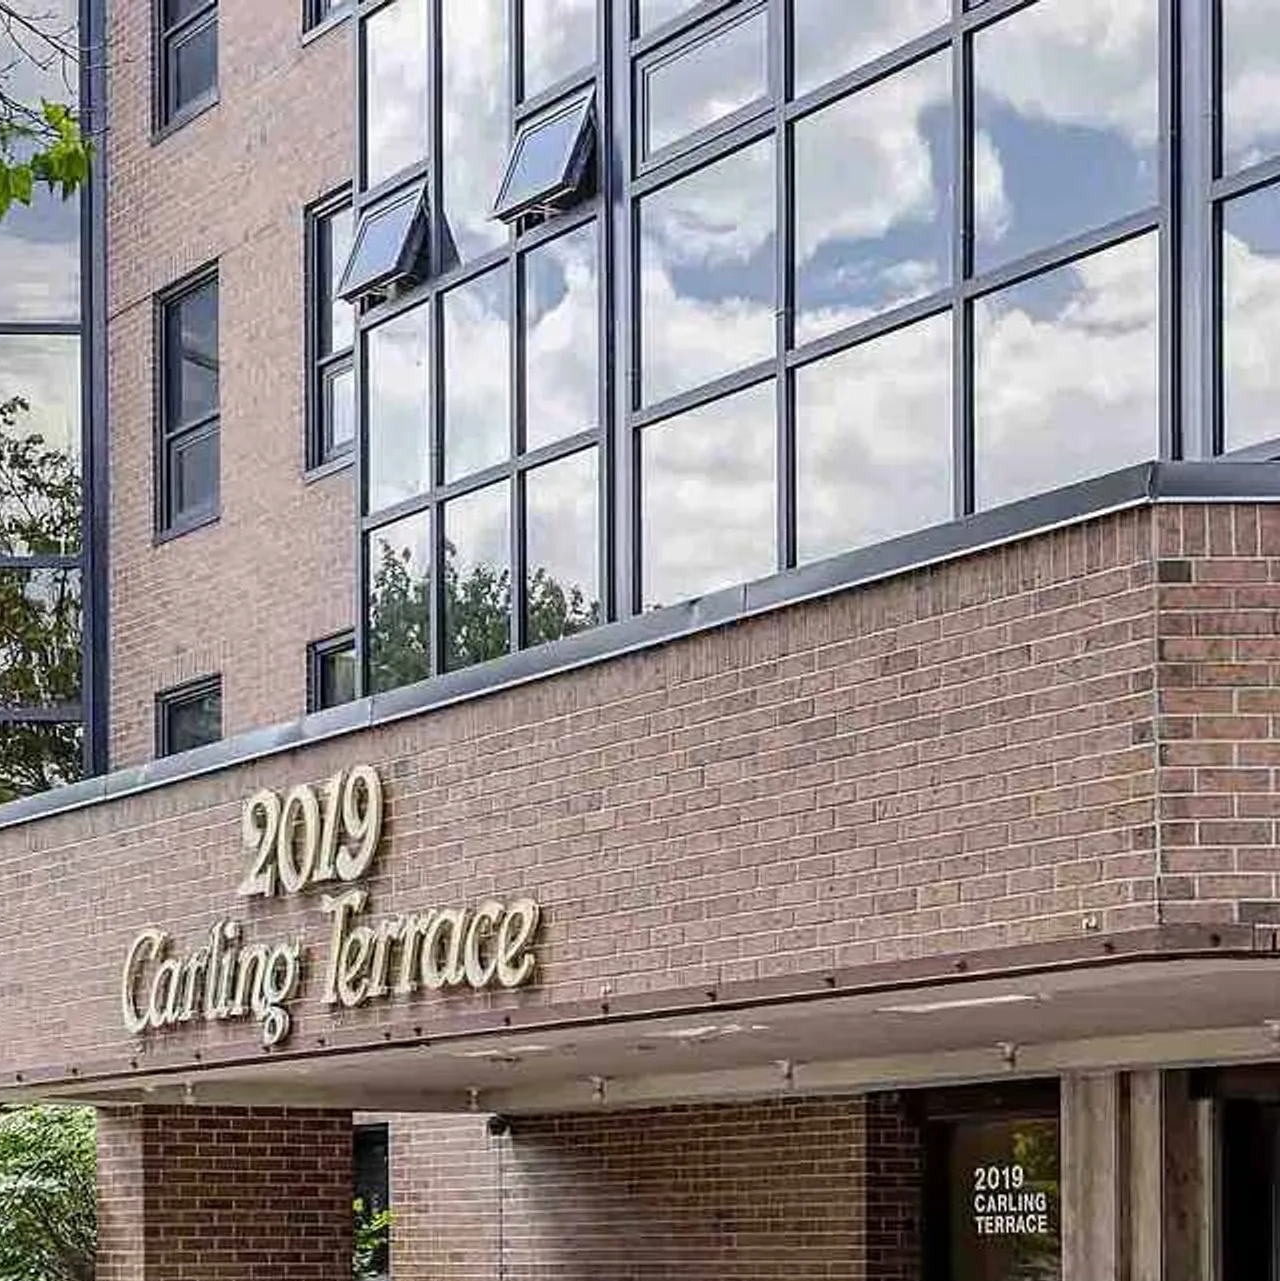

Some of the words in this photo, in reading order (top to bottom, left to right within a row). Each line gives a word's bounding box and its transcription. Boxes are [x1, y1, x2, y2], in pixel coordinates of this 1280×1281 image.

[238, 764, 384, 897] 2019
[123, 920, 302, 1045] Carling
[322, 889, 540, 1007] Terrace
[974, 1165, 1024, 1191] 2019
[974, 1192, 1047, 1213] CARLING
[974, 1214, 1048, 1234] TERRACE
